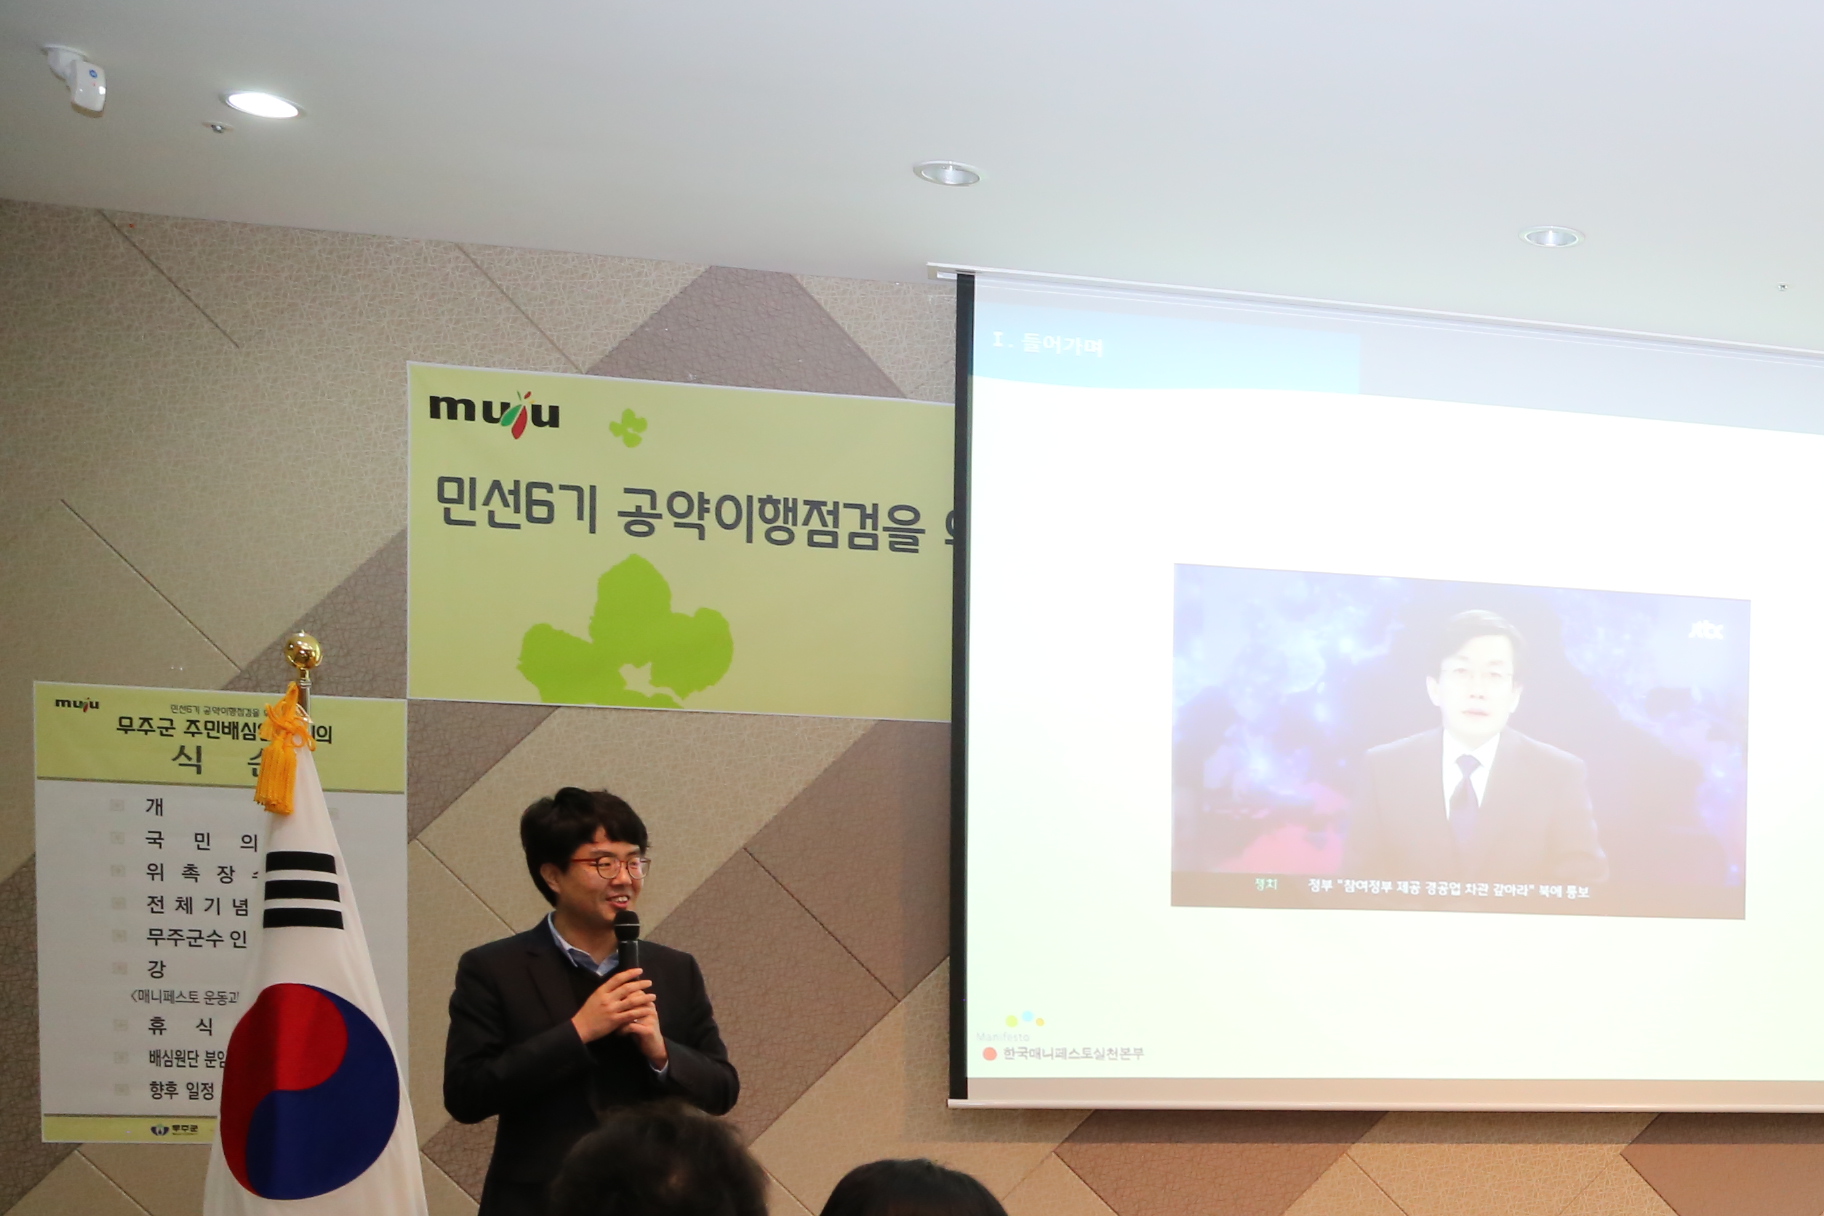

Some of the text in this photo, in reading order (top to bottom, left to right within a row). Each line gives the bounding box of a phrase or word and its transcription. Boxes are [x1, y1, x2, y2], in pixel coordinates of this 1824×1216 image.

[429, 390, 560, 440] muju
[436, 475, 597, 535] 민선6기
[617, 485, 927, 555] 공약이행점검을
[170, 704, 200, 715] 민선6기
[116, 716, 176, 738] 무주군
[1566, 885, 1591, 900] 통보
[146, 928, 225, 948] 무주군수
[147, 960, 167, 979] 강
[149, 1048, 200, 1068] 배심원단
[1003, 1047, 1145, 1061] 한국매니페스토실천본부
[149, 1080, 214, 1101] 향후 일정
